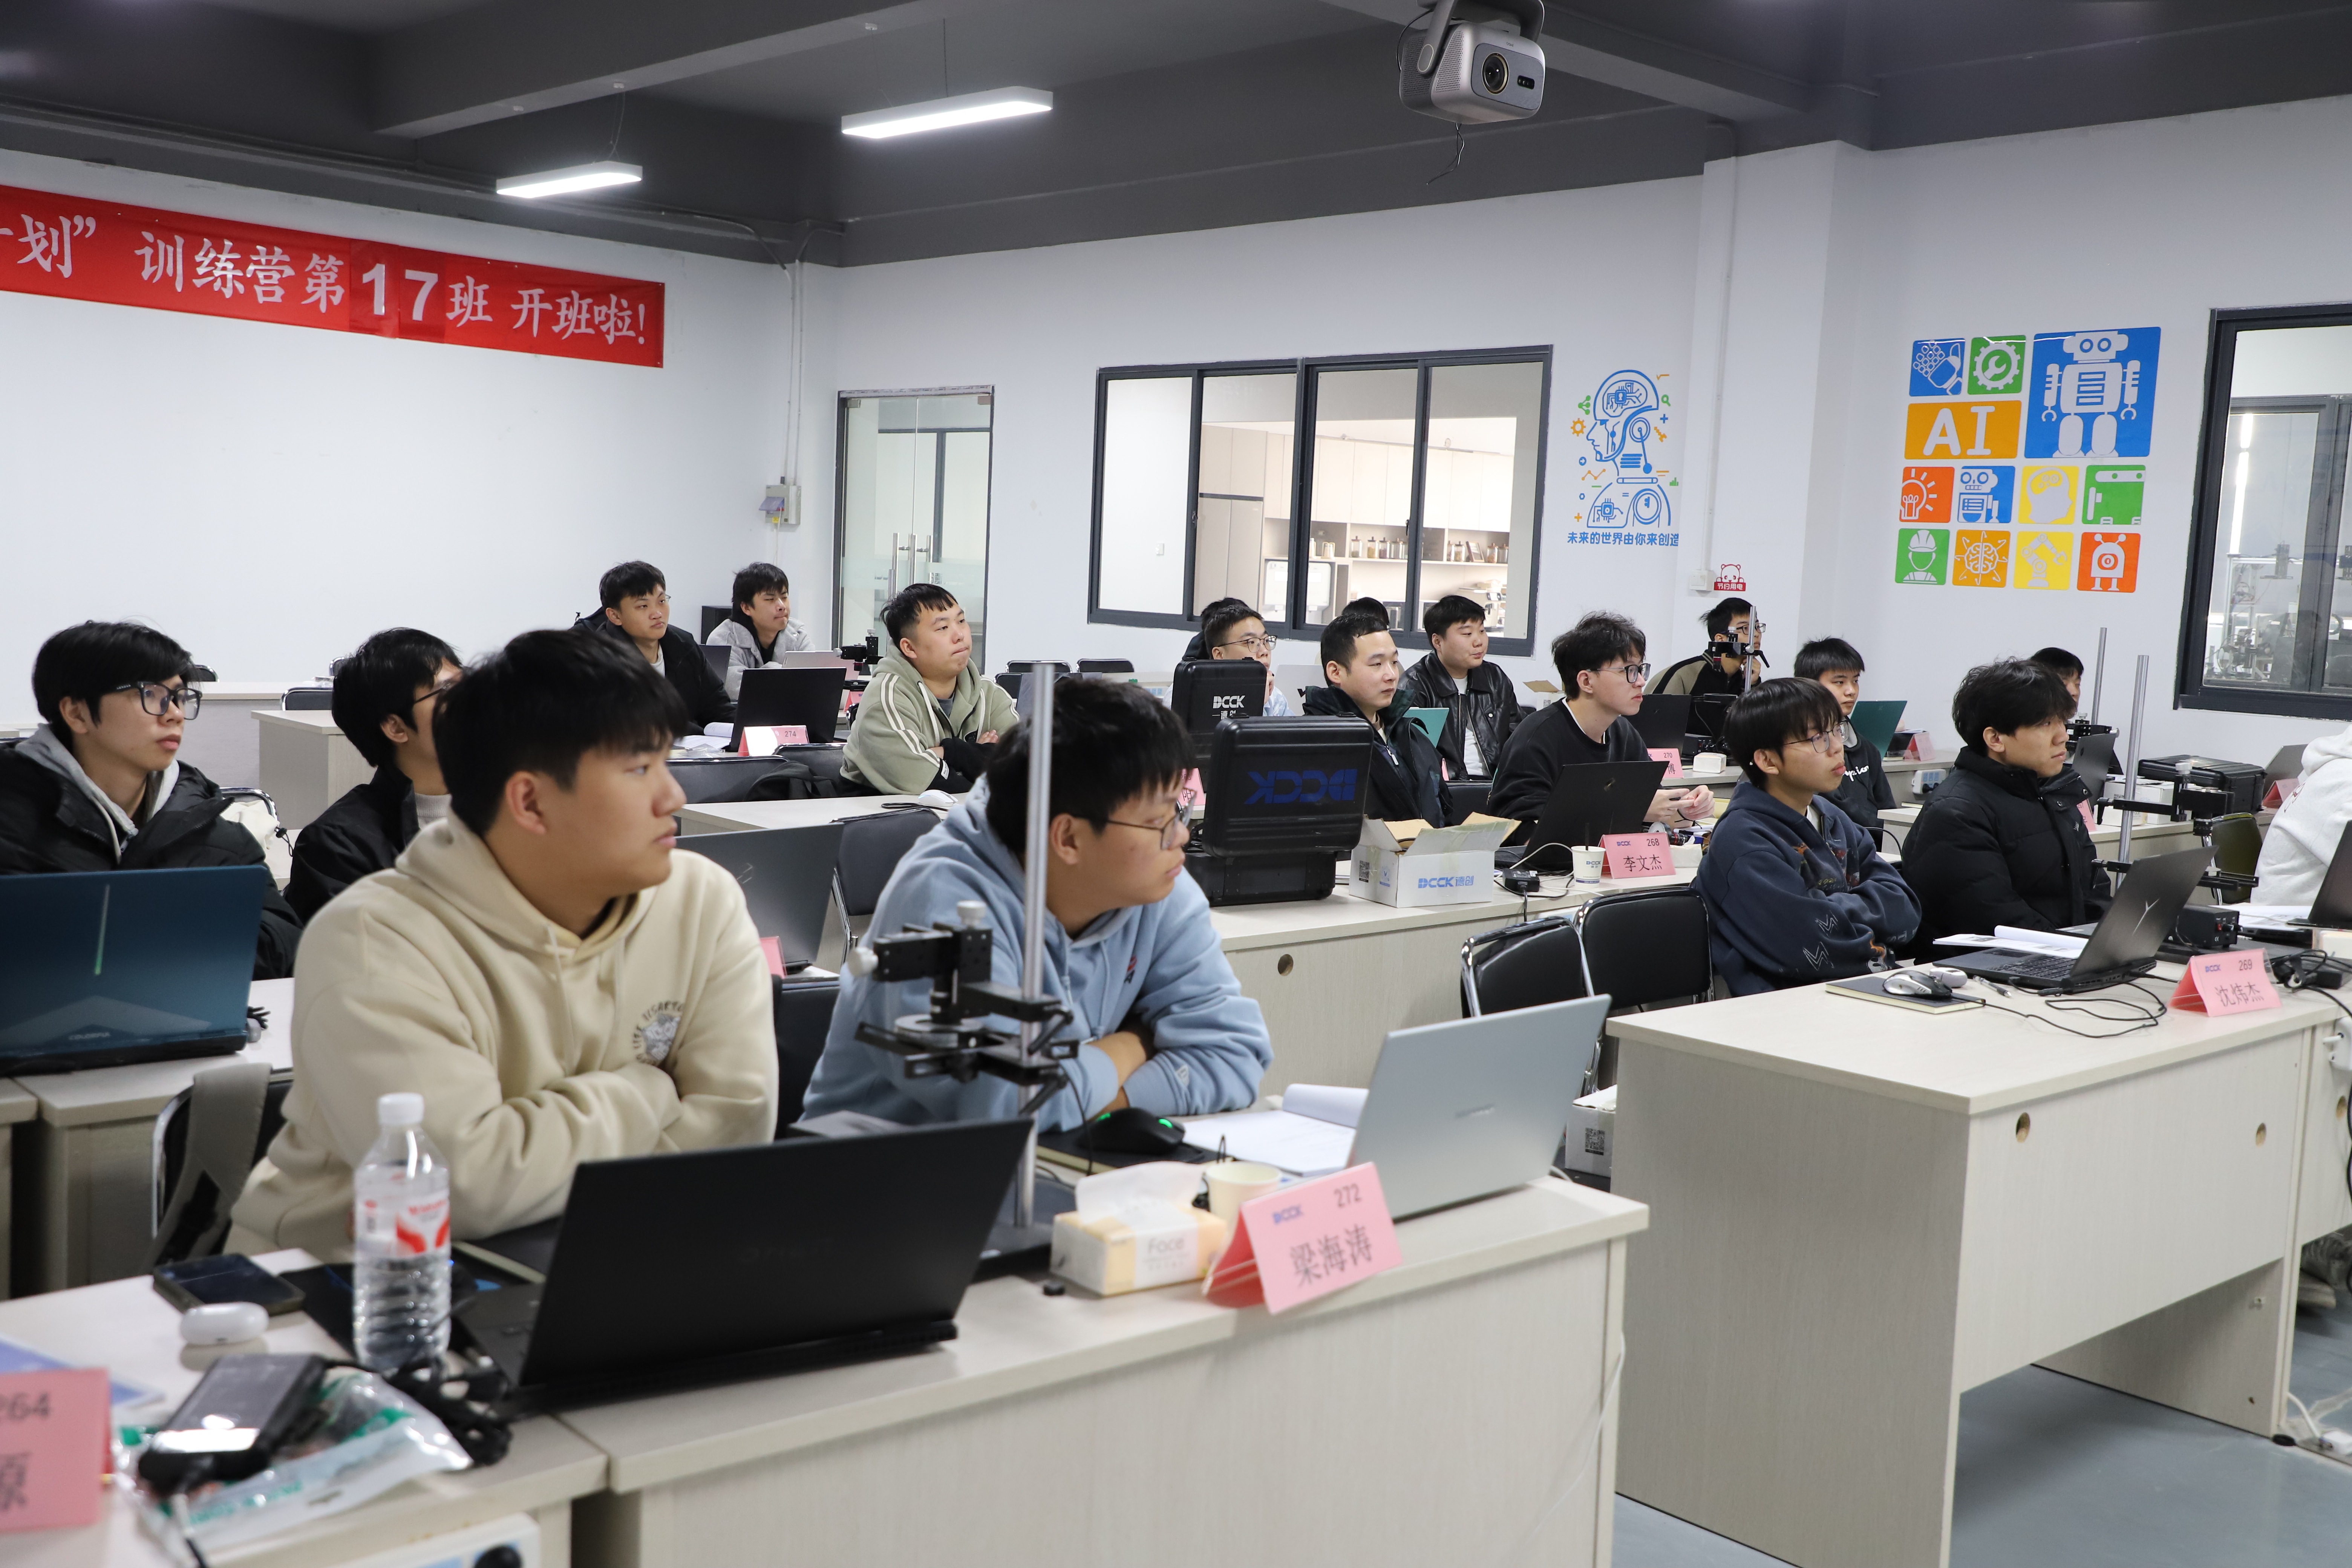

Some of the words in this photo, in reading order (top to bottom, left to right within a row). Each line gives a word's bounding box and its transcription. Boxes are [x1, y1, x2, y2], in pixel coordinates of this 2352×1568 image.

[0, 214, 96, 278] 划”
[1923, 406, 1995, 456] AI
[1567, 531, 1679, 546] 未来的世界由你来创造
[1213, 695, 1245, 709] DCCK
[1245, 769, 1357, 804] DCCK
[1646, 838, 1660, 847] 268
[1623, 854, 1662, 872] 李文杰
[1418, 877, 1455, 888] DCCK
[2205, 964, 2221, 972] DCCK
[2239, 959, 2252, 971] 269
[1334, 1182, 1363, 1208] 272
[1289, 1223, 1372, 1287] 梁海涛
